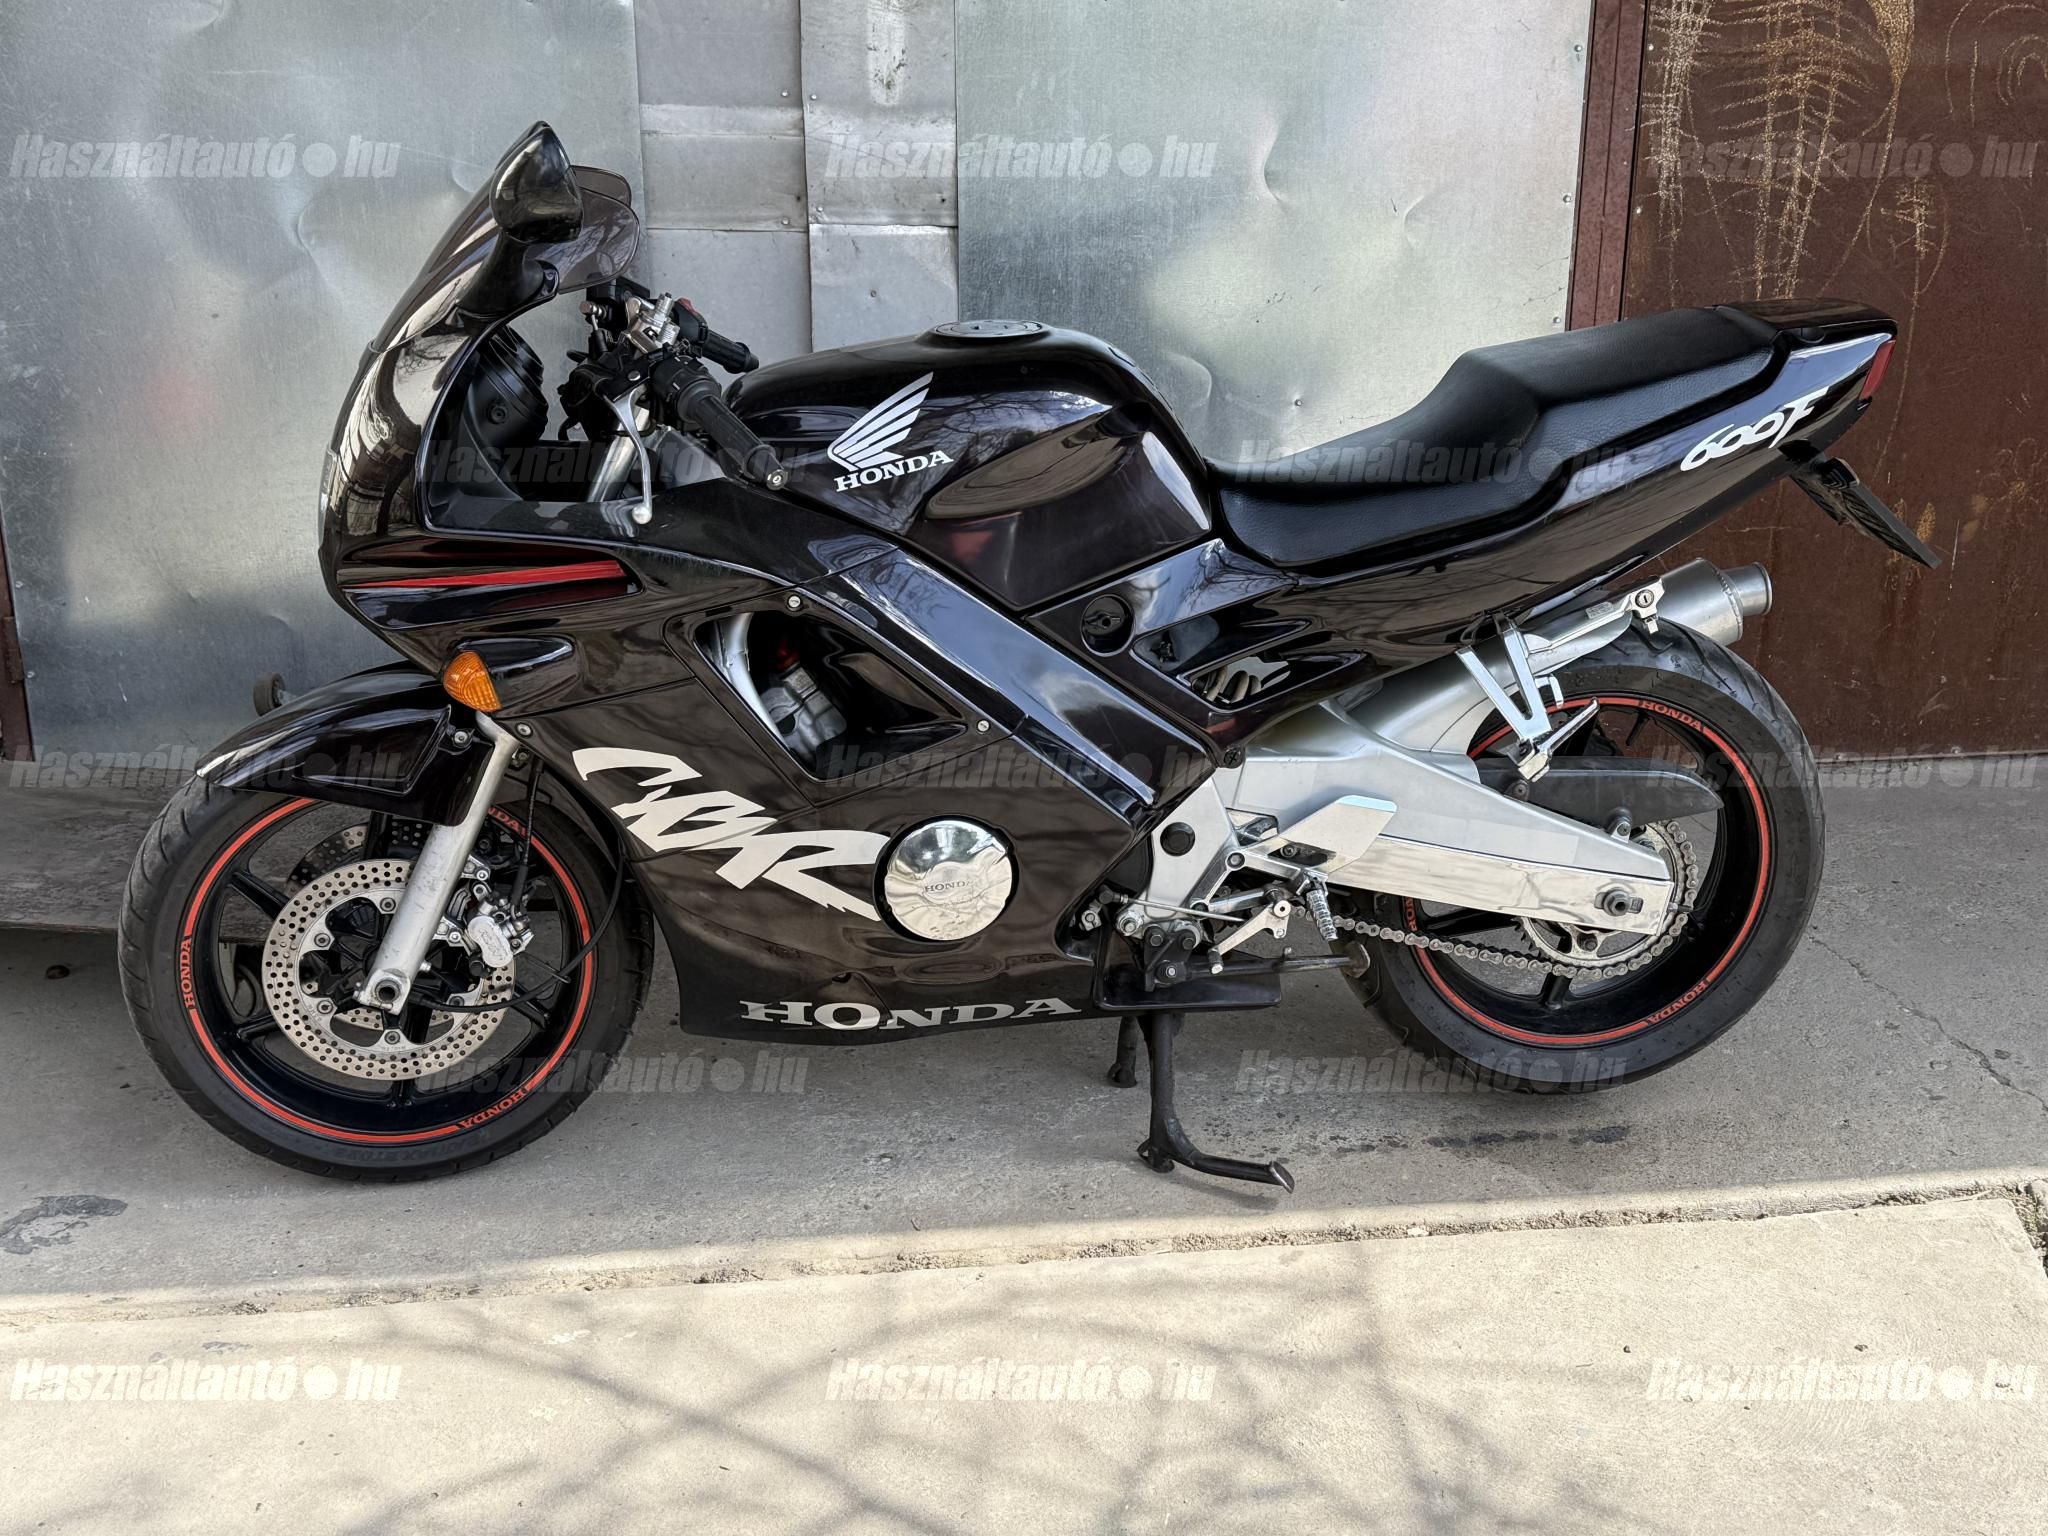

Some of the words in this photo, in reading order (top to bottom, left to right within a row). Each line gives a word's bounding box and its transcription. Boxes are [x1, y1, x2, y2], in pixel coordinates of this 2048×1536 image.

[834, 450, 954, 492] HONDA
[1641, 700, 1704, 732] HONDA
[572, 747, 891, 922] CBR
[180, 936, 195, 1008] HONDA
[739, 997, 1083, 1031] HONDA
[1648, 981, 1708, 1023] HONDA
[460, 1087, 527, 1129] HONDA
